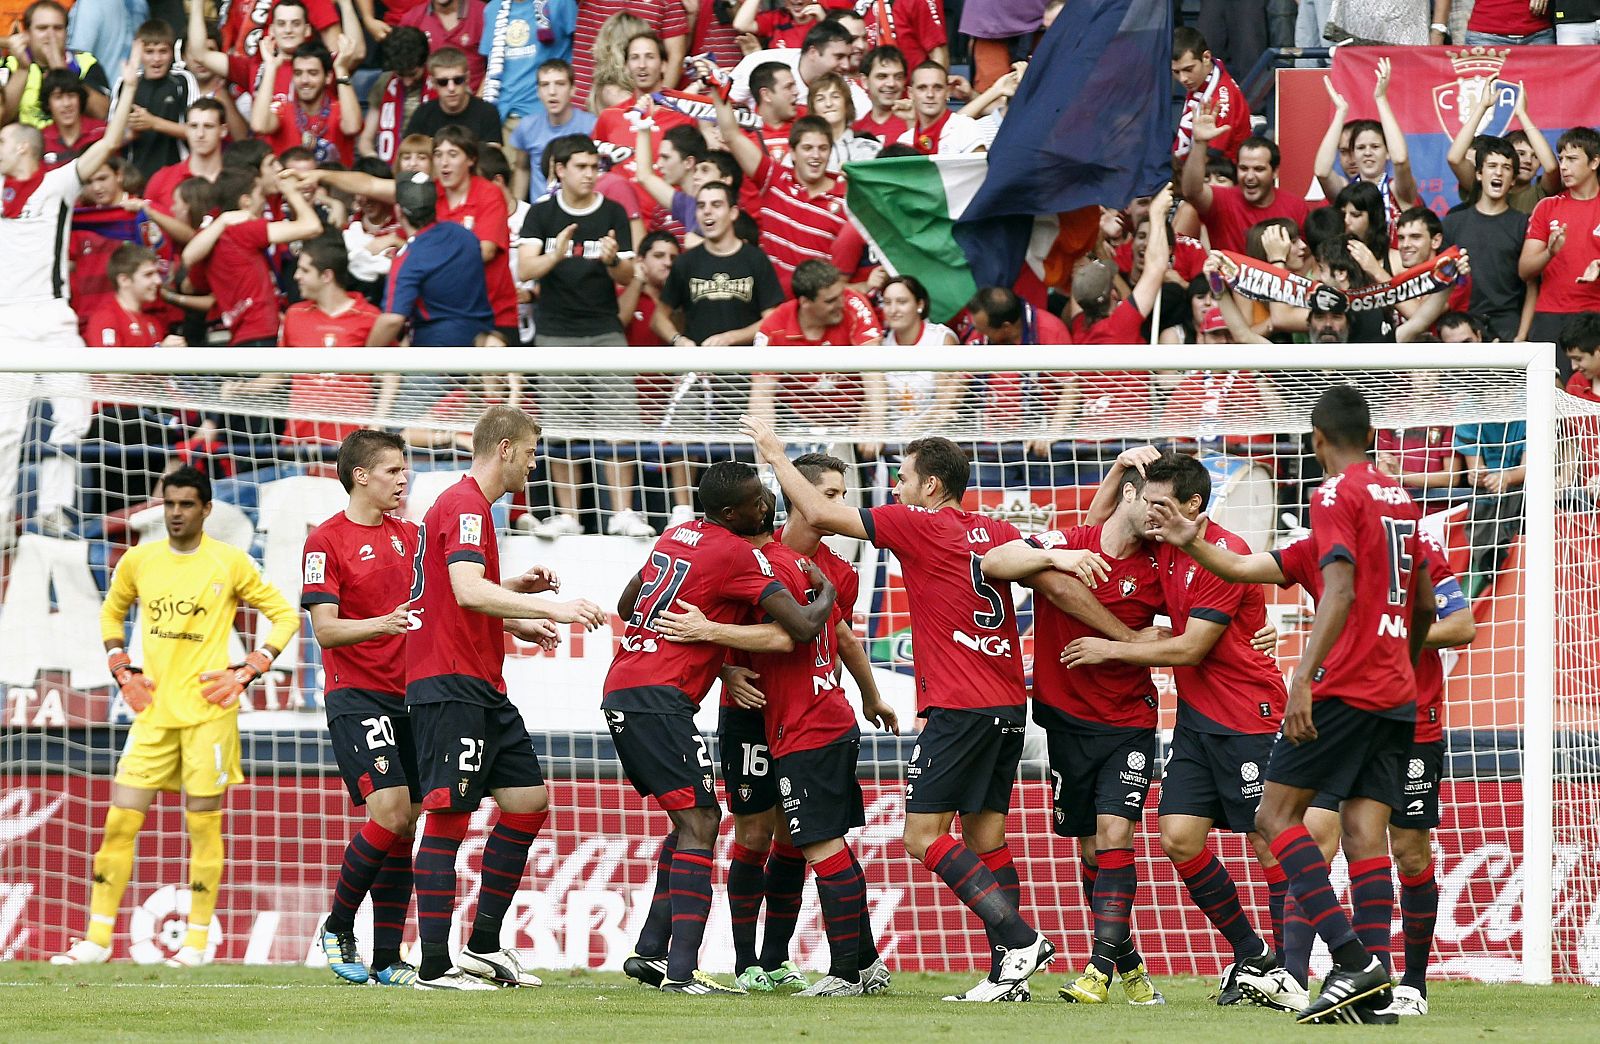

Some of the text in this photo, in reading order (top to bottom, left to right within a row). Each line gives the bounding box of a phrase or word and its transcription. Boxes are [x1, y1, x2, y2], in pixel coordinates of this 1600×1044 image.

[1350, 270, 1436, 312] OSASUNA
[1380, 515, 1417, 608] 15
[969, 550, 1006, 630] 5
[150, 594, 208, 622] gijón
[361, 715, 396, 751] 20
[458, 737, 485, 772] 23
[691, 734, 711, 768] 2
[741, 743, 769, 777] 16
